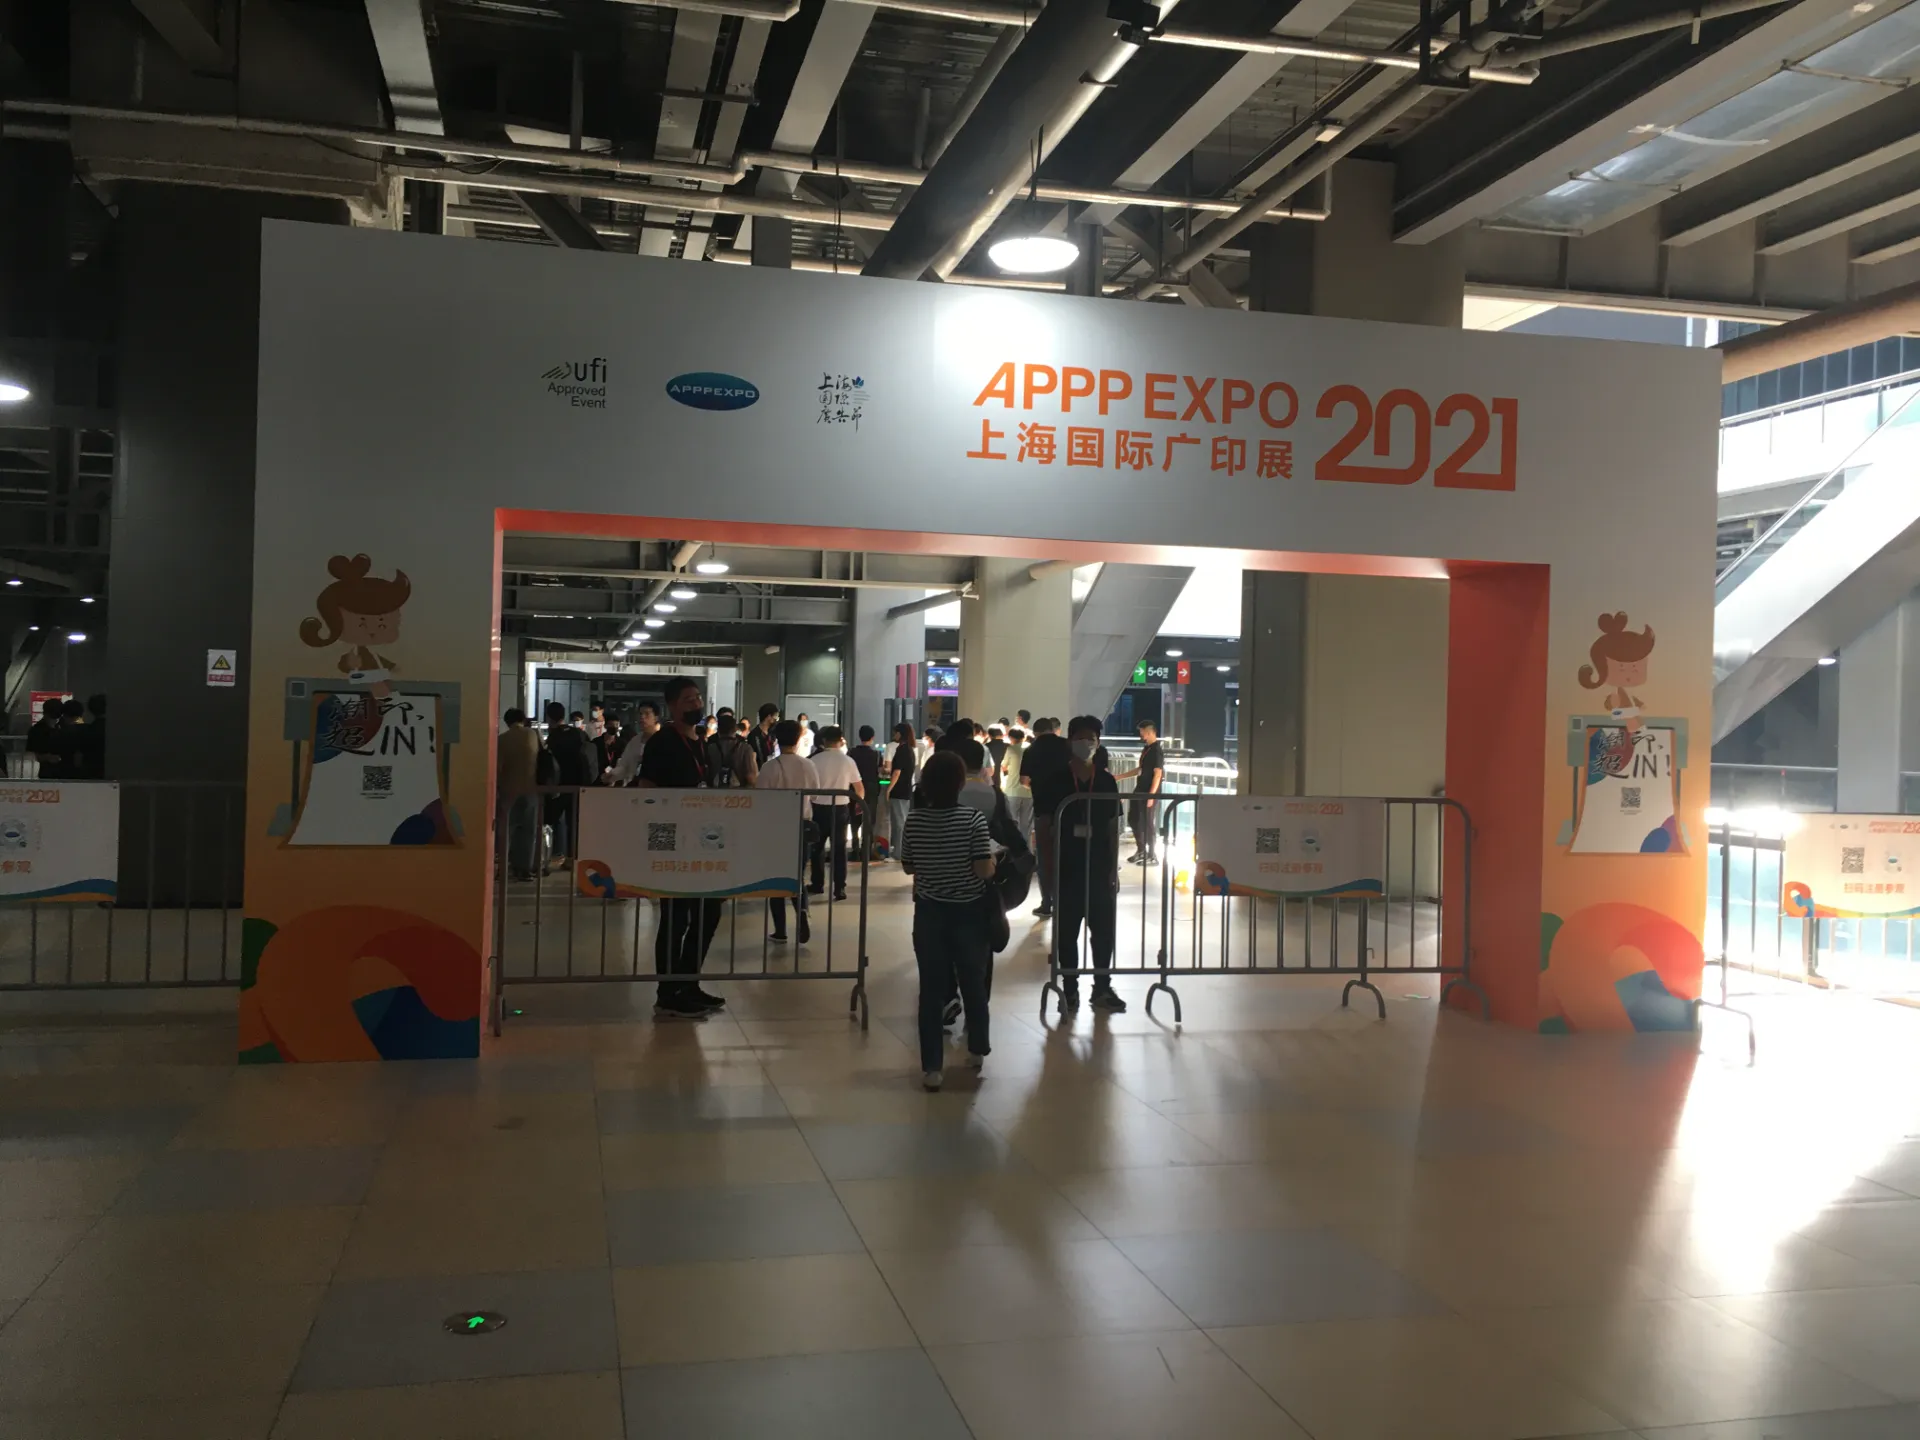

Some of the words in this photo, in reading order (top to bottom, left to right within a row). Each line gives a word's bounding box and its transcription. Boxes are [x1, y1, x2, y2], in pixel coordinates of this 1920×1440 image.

[574, 357, 607, 383] ufi
[547, 382, 606, 397] Approved
[669, 383, 756, 399] APPPEXPO
[571, 396, 606, 409] Event
[1143, 372, 1299, 430] EXPO
[1314, 384, 1519, 492] 2021
[966, 418, 1294, 481] 上海国际广印展
[26, 789, 60, 804] 2021
[724, 796, 753, 809] 2021
[1320, 803, 1344, 815] 2021
